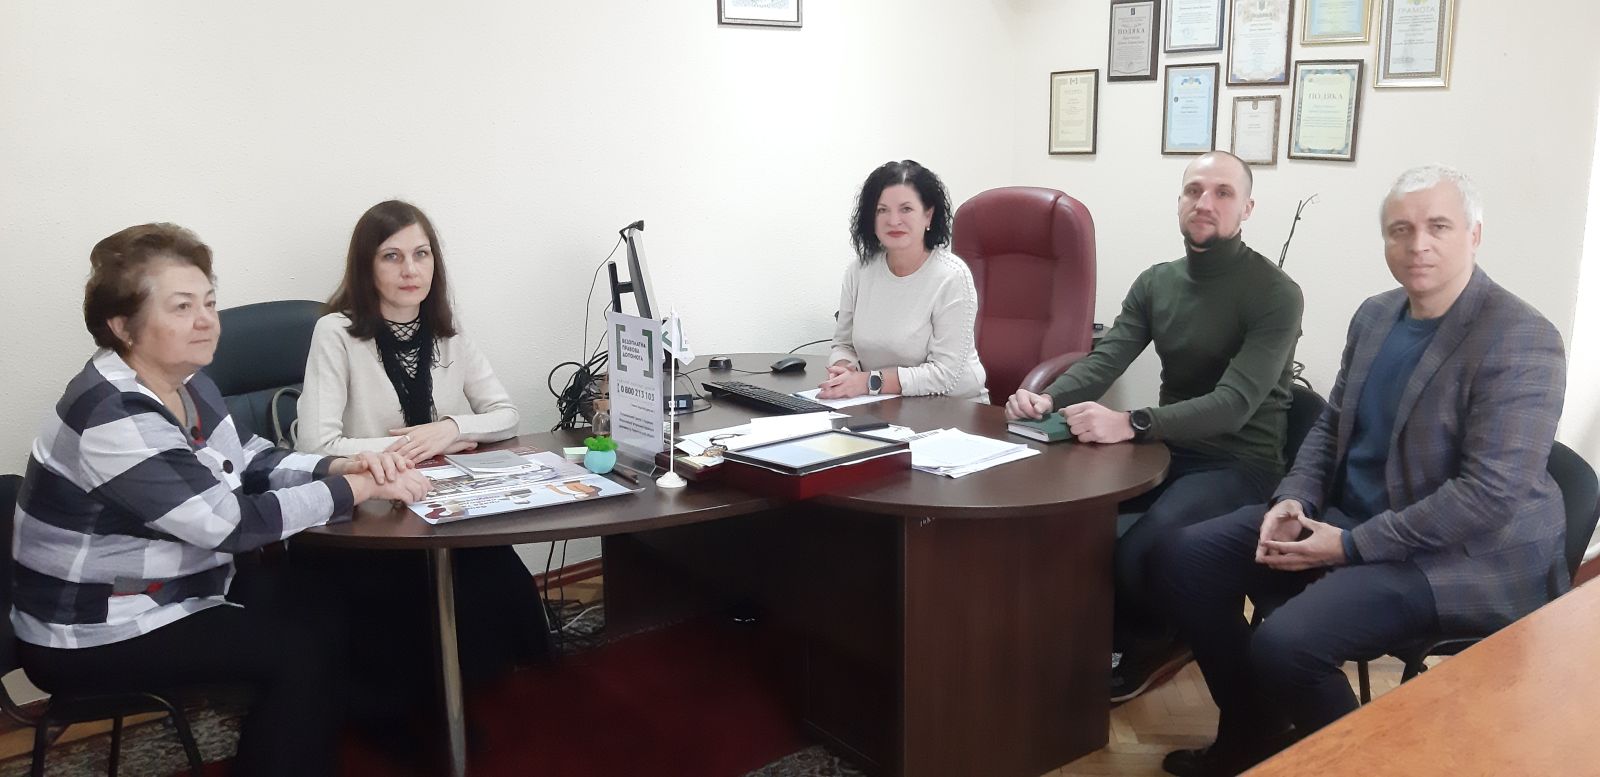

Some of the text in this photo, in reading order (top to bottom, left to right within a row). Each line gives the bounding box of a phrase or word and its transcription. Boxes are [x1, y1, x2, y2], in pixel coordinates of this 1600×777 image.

[621, 338, 646, 348] БЕЗОПЛАТНА
[621, 345, 640, 354] ПРАВОВА
[622, 352, 644, 361] ДОПОМОГА
